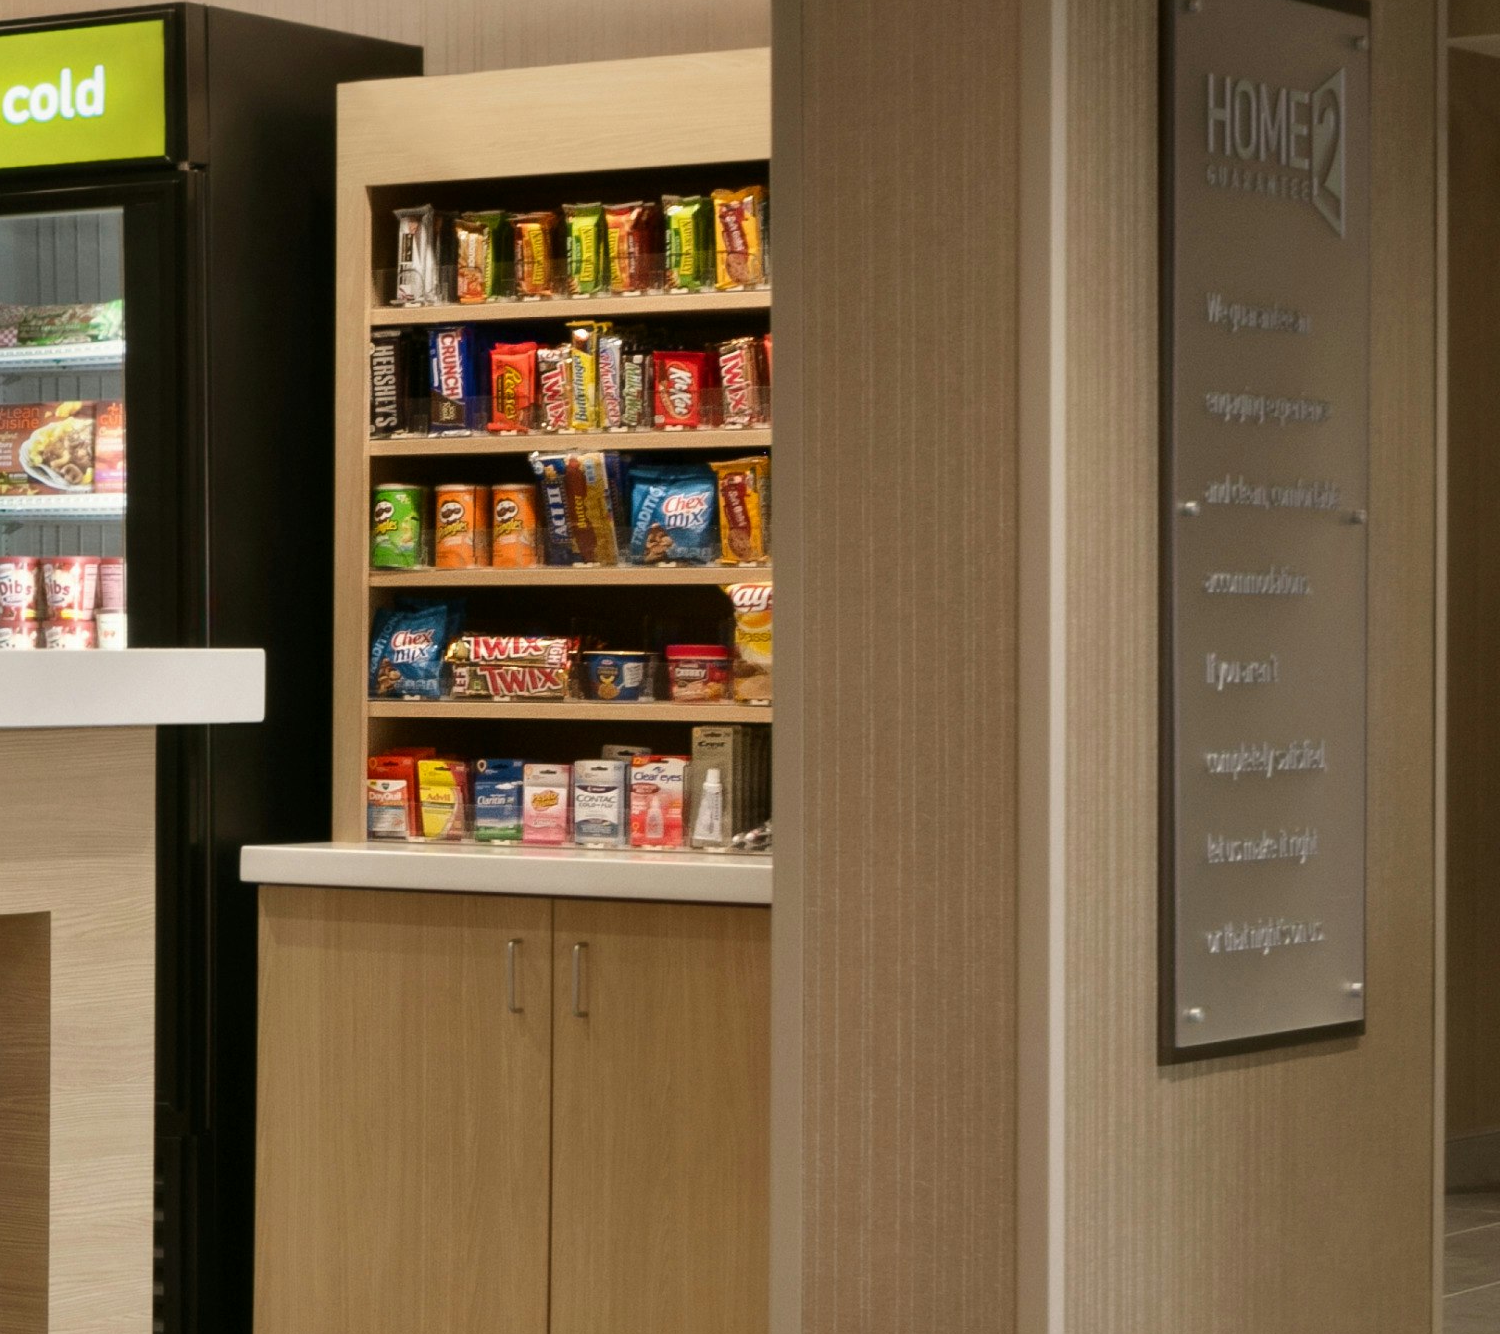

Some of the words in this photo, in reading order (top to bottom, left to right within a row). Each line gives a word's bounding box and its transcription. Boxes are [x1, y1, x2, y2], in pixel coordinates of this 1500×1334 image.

[2, 65, 105, 126] cold
[440, 334, 460, 398] CRUNCH
[372, 345, 398, 428] HERSHEY'S
[720, 349, 751, 414] TWIX
[541, 360, 568, 432] TWIX
[663, 491, 708, 514] Chex
[667, 508, 702, 529] mix
[391, 628, 435, 649] Chex
[464, 634, 544, 662] TWIX
[478, 665, 562, 696] TWIX
[634, 771, 658, 781] Clear
[660, 774, 682, 783] eyes
[368, 791, 402, 802] DayQuil
[426, 793, 450, 802] Advil
[477, 796, 506, 806] Claritin
[576, 794, 616, 804] CONTAC
